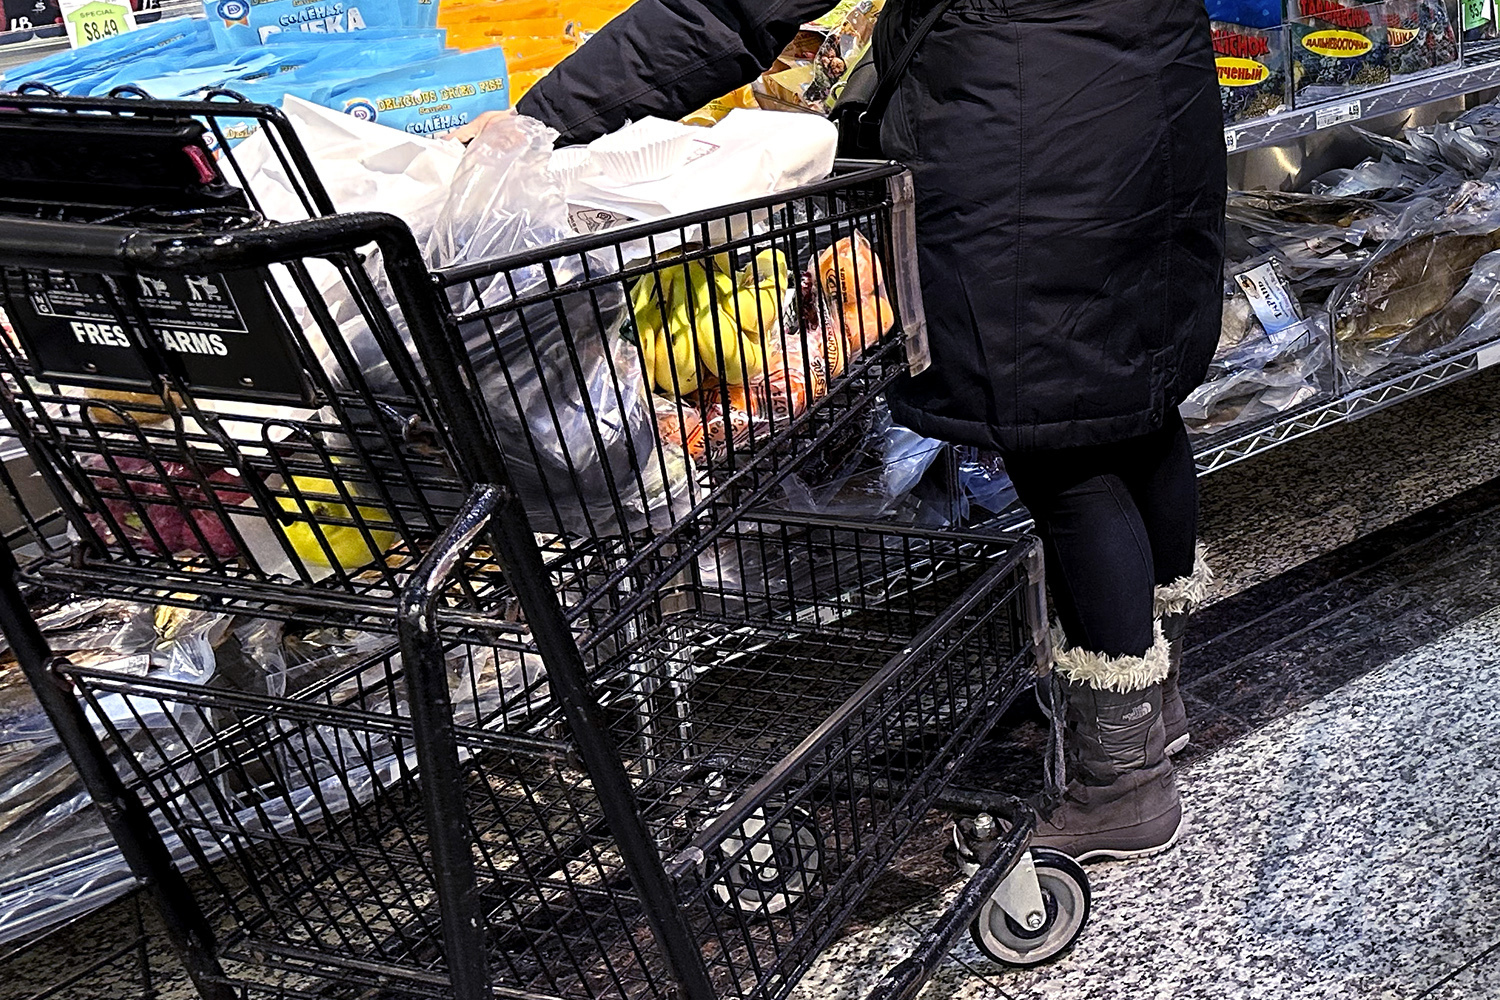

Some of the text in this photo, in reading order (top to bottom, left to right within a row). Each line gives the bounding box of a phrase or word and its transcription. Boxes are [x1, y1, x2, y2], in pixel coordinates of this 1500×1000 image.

[11, 17, 33, 31] LB
[79, 8, 115, 19] SPECIAL
[83, 19, 119, 42] $8.49
[376, 91, 437, 112] DELICIOUS
[440, 84, 476, 100] DRIED
[480, 78, 504, 92] FISH
[404, 114, 469, 136] СОЛЁНАЯ
[70, 321, 228, 356] FRES ARMS
